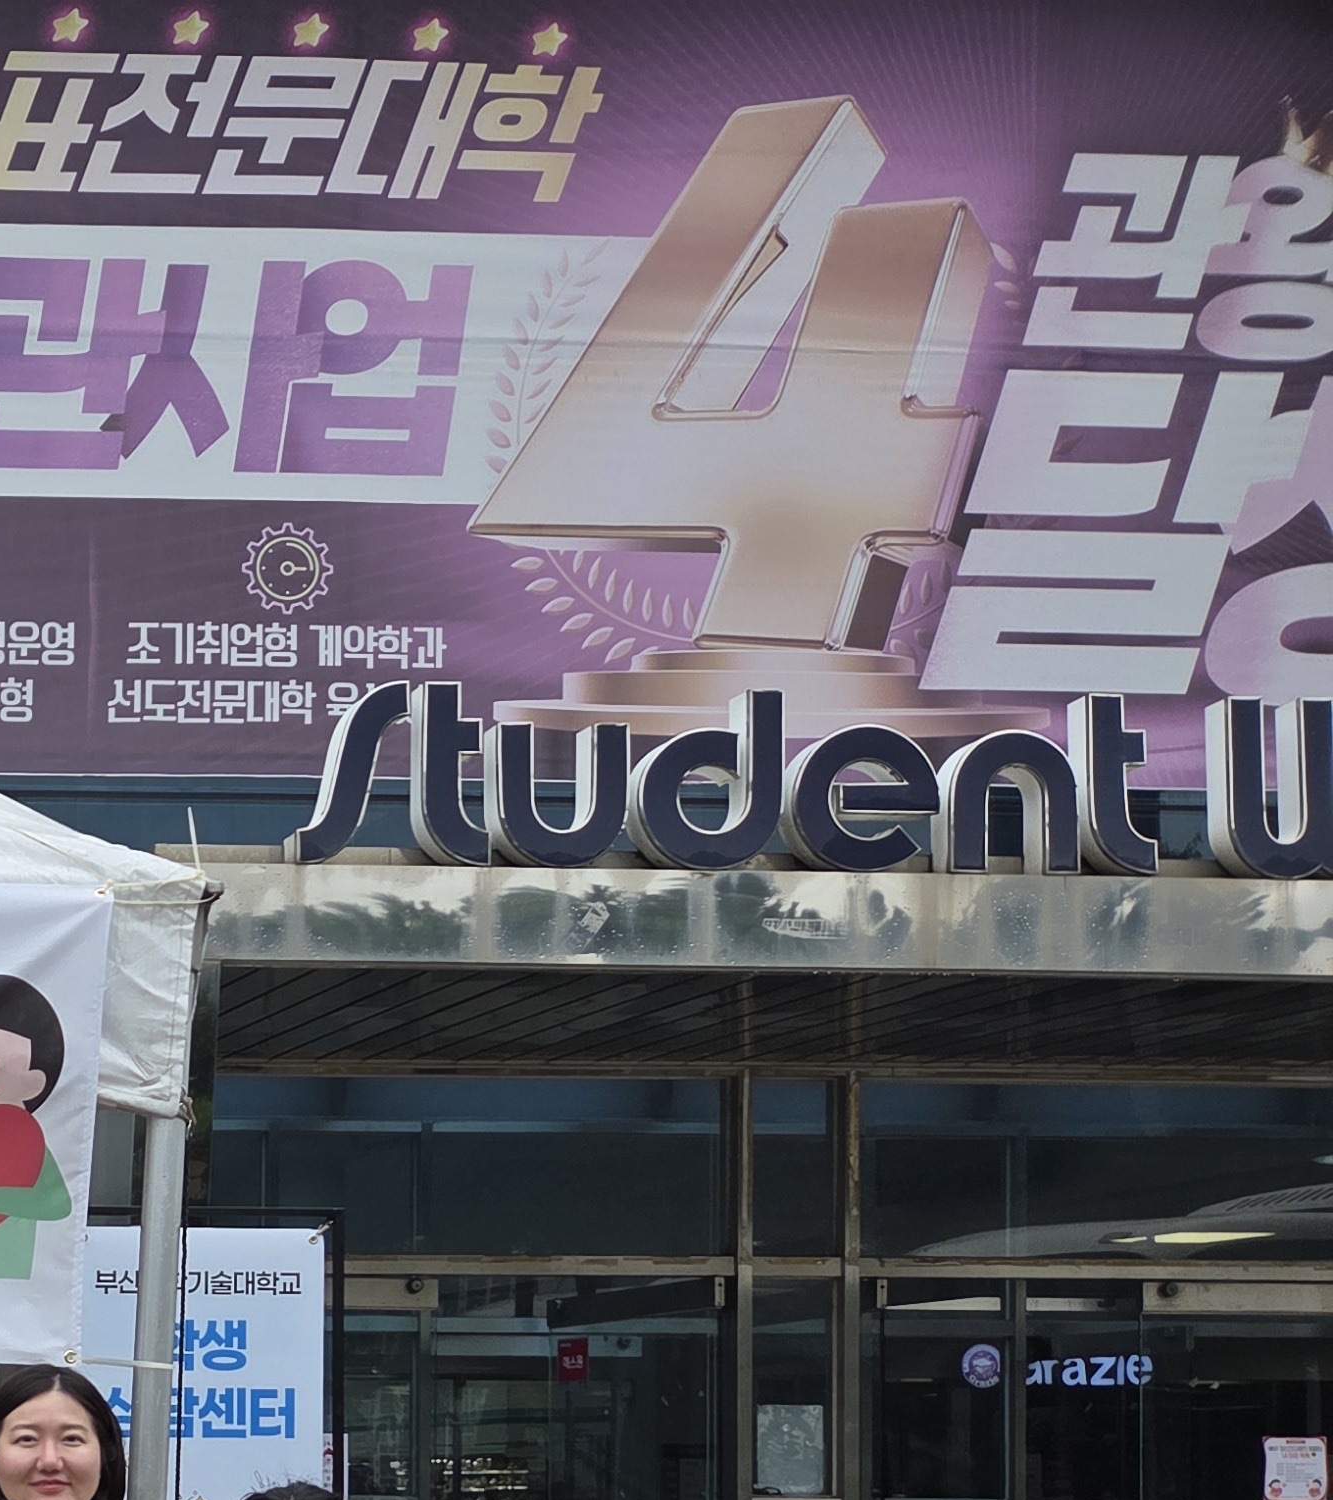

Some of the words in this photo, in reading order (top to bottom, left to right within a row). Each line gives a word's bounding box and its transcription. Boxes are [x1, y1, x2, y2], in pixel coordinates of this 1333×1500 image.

[126, 621, 298, 668] 조기취업형
[309, 624, 447, 669] 계약학과
[107, 679, 317, 725] 선도전문대학
[284, 681, 1159, 876] Student
[95, 1270, 302, 1296] 부산기술대학교
